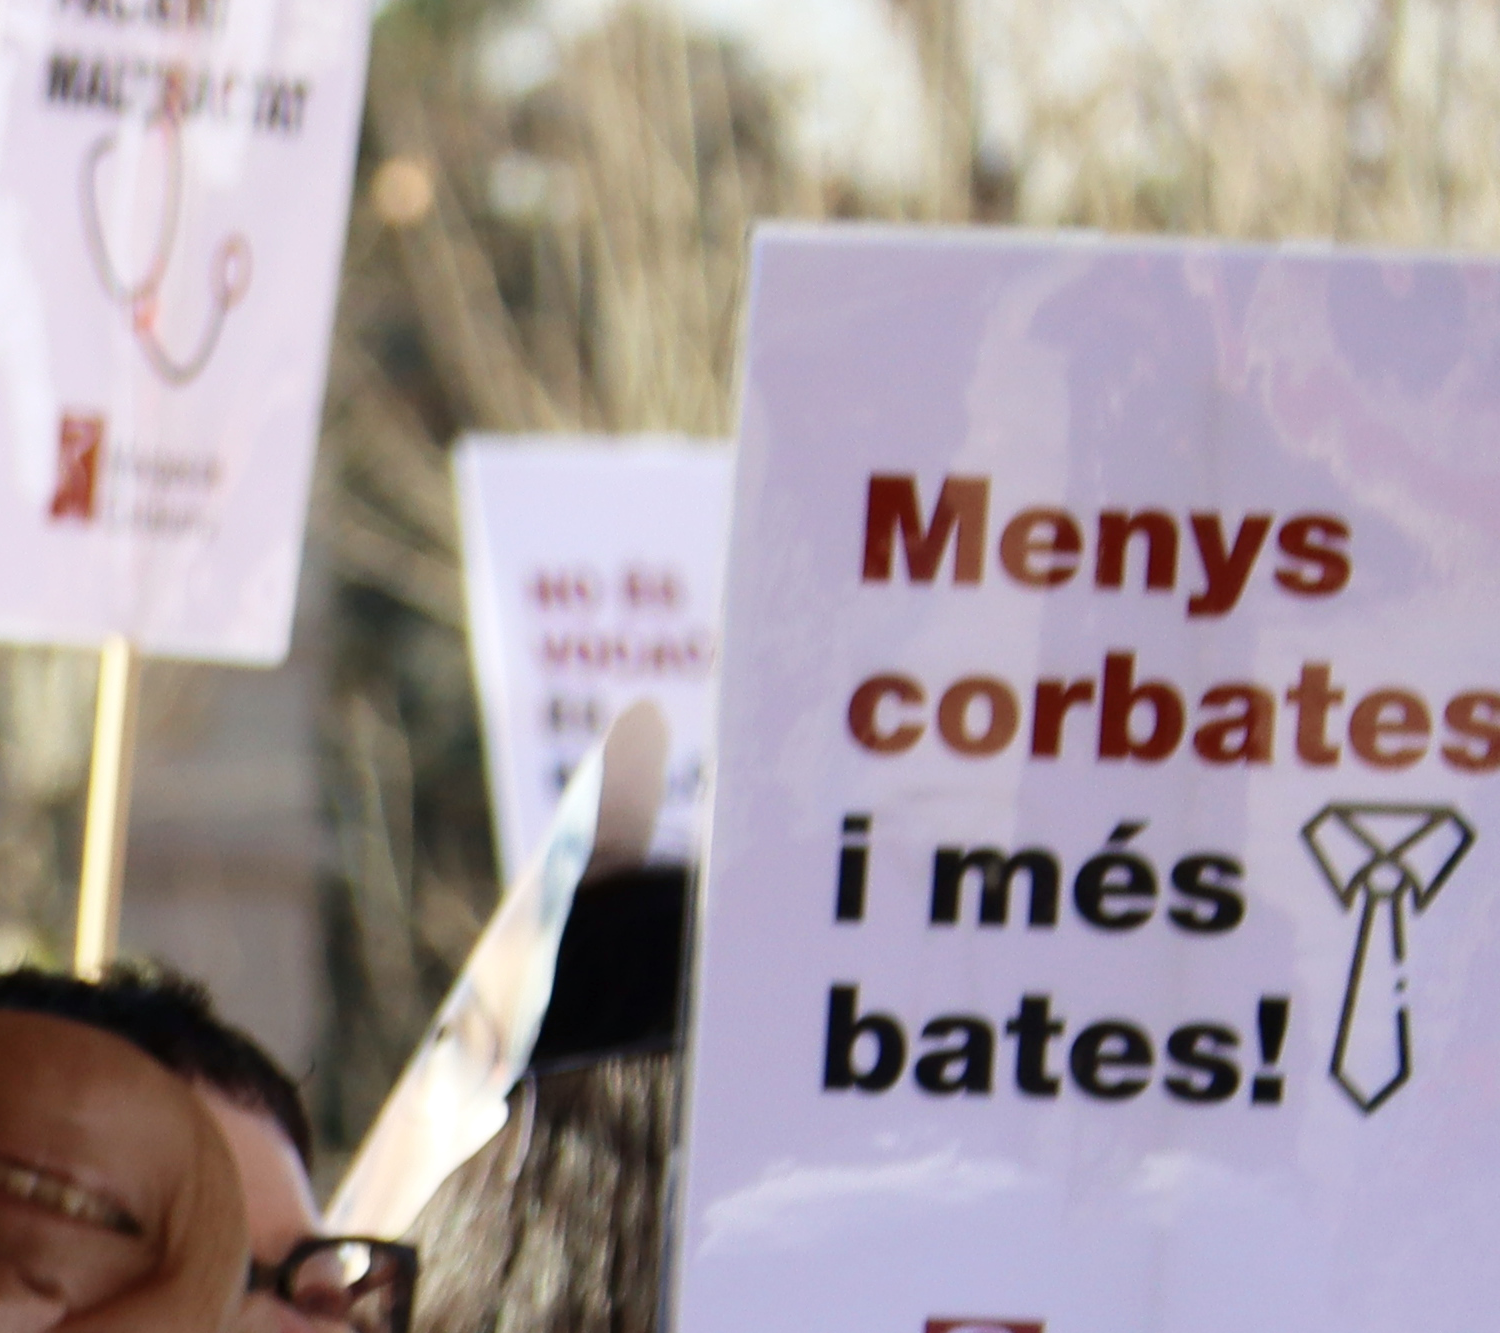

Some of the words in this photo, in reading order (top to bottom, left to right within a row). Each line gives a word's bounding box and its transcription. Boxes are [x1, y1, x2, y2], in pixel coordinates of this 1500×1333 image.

[860, 472, 1353, 620] Menys
[847, 650, 1500, 773] corbates
[833, 814, 872, 924] i
[928, 822, 1247, 935] més
[821, 984, 1291, 1105] bates!
